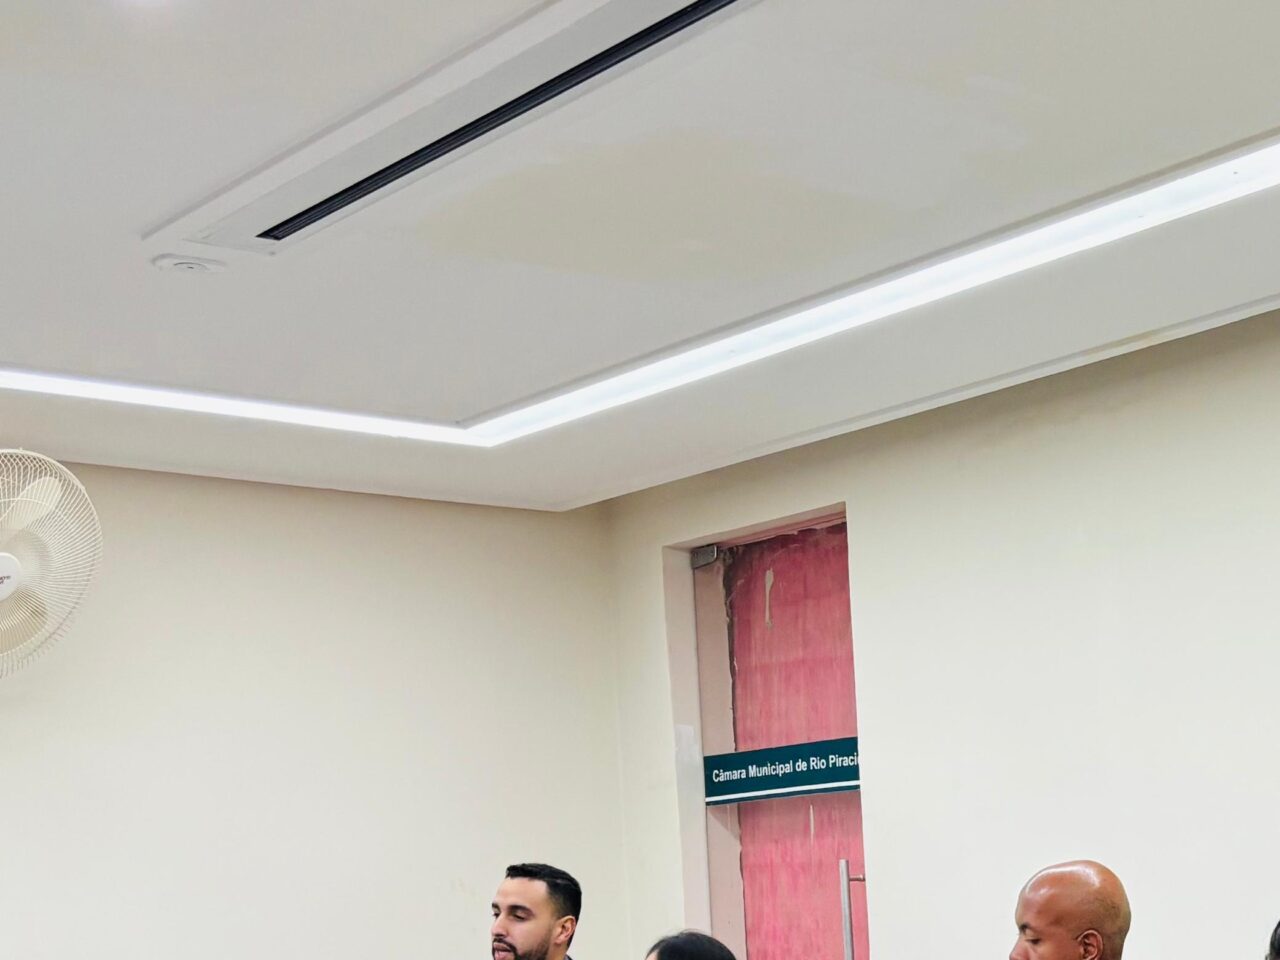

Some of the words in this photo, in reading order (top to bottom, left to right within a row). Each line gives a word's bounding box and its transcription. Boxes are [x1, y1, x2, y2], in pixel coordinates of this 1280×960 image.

[712, 769, 746, 782] Câmara
[748, 760, 793, 777] Municipal
[795, 759, 808, 772] de
[810, 756, 827, 770] Rio
[829, 752, 859, 768] Piraci
